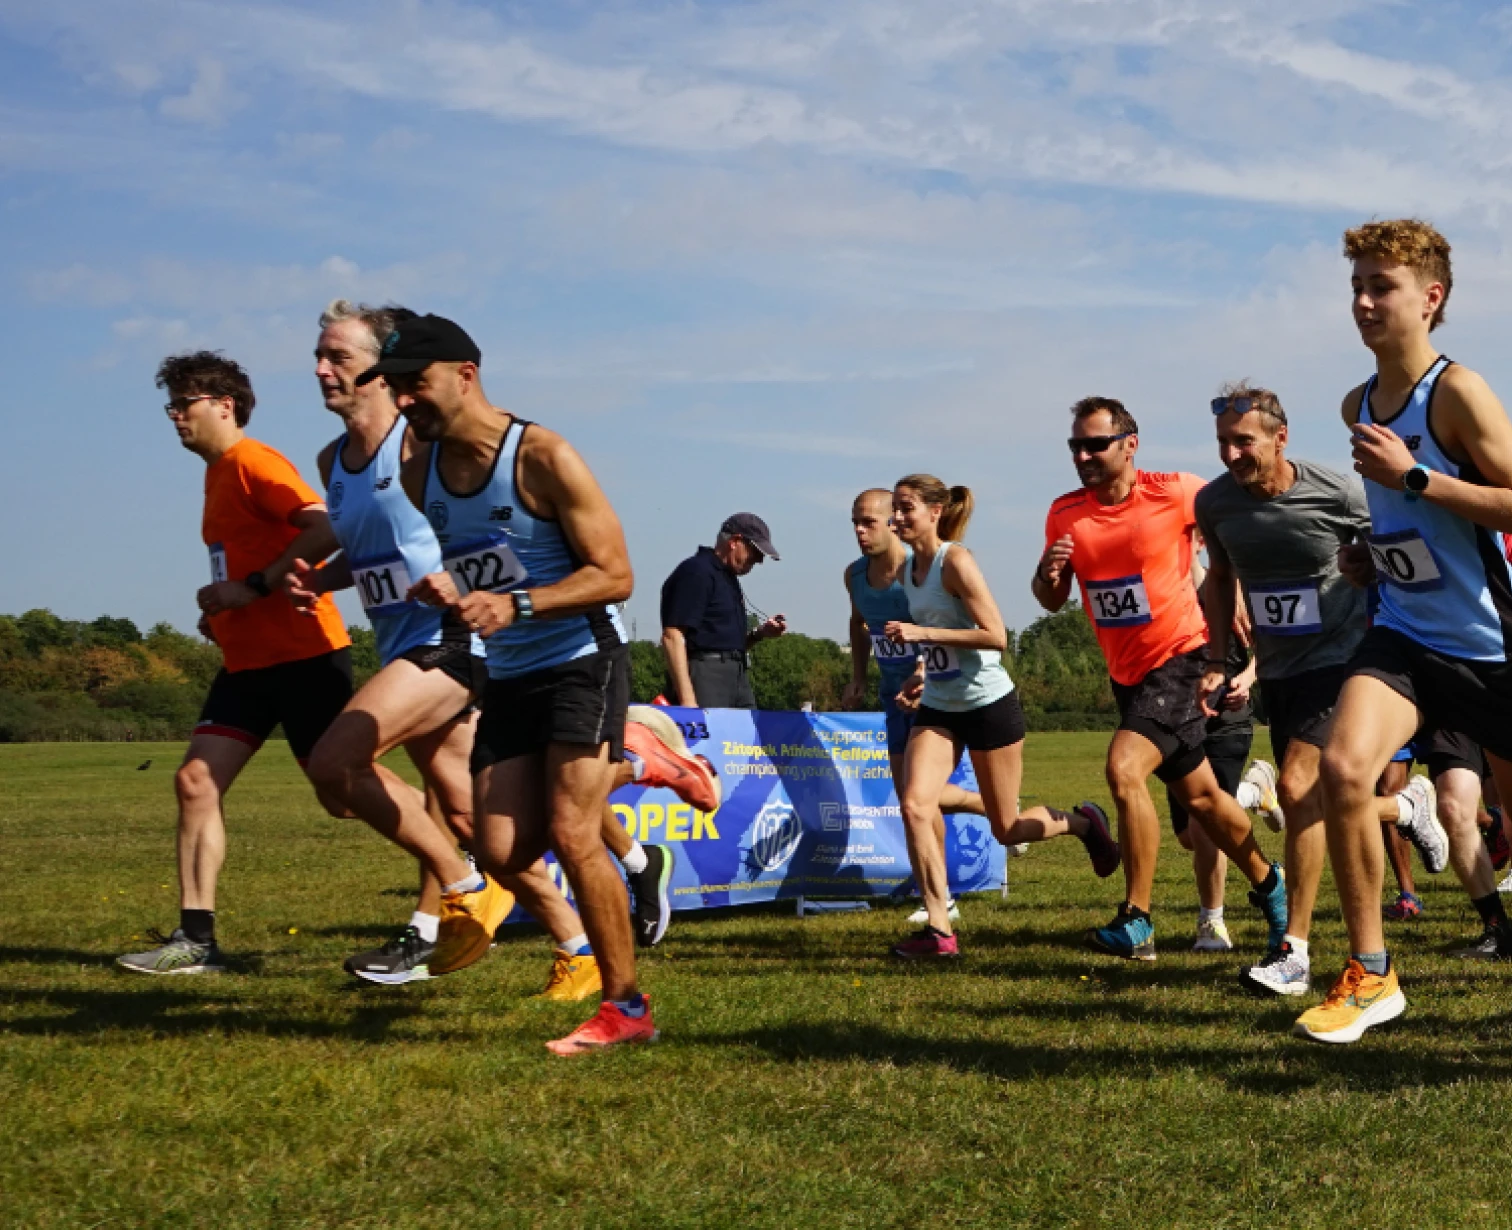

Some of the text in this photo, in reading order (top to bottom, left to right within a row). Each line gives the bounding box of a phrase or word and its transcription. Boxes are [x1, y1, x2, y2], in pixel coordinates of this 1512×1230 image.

[359, 567, 398, 605] 101
[455, 551, 516, 591] 122
[1095, 588, 1141, 618] 134
[1264, 594, 1302, 626] 97
